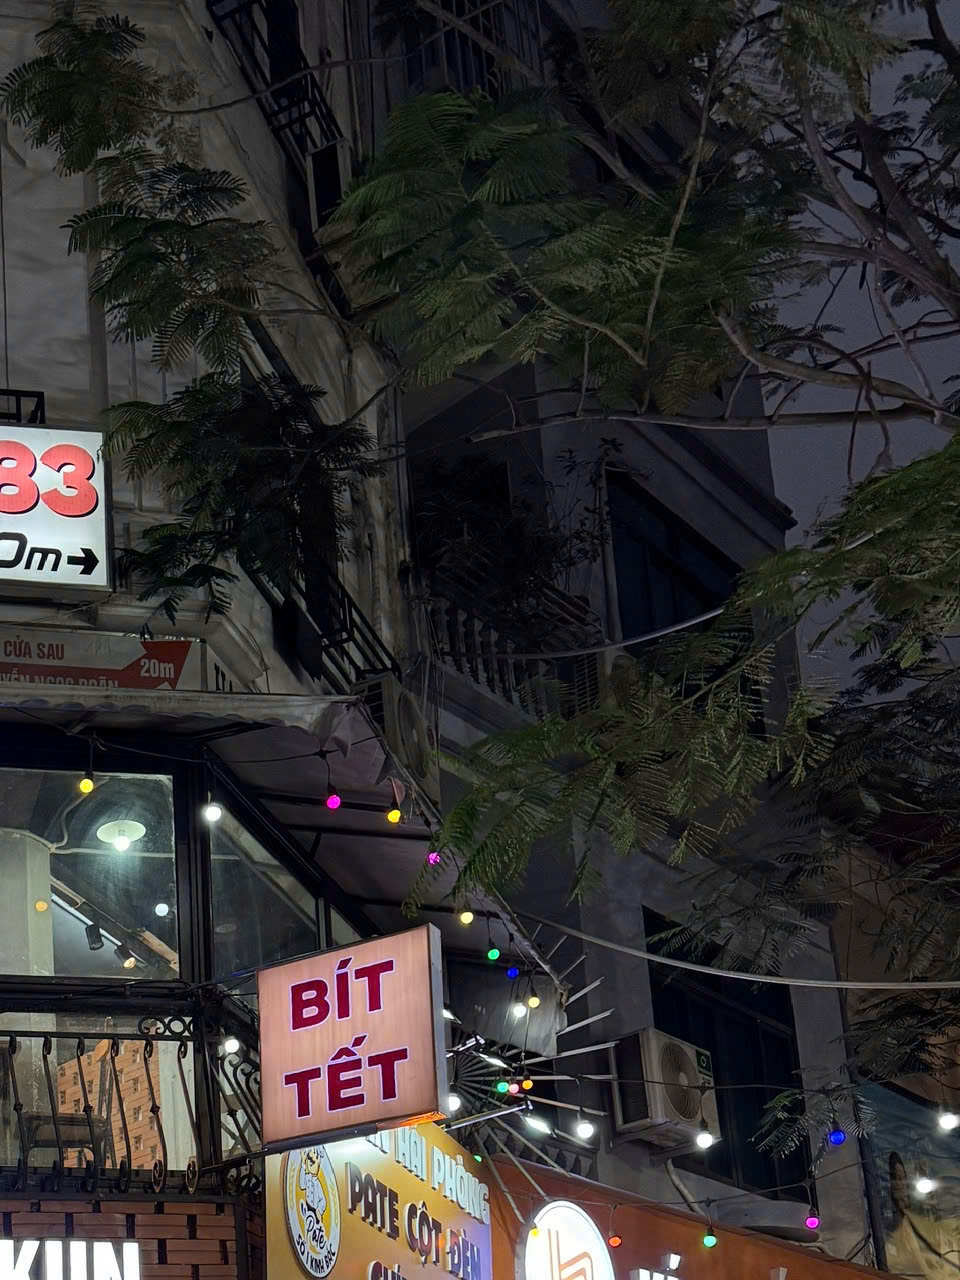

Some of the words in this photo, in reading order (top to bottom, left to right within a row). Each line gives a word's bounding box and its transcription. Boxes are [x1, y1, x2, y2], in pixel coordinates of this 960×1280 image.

[3, 634, 32, 658] CỬA
[36, 642, 65, 660] SAU
[140, 658, 175, 679] 20m
[290, 957, 394, 1031] BÍT
[284, 1034, 408, 1118] TẾT
[345, 1161, 400, 1240] PATE
[431, 1145, 490, 1224] PHÒNG
[404, 1201, 442, 1268] CỘT
